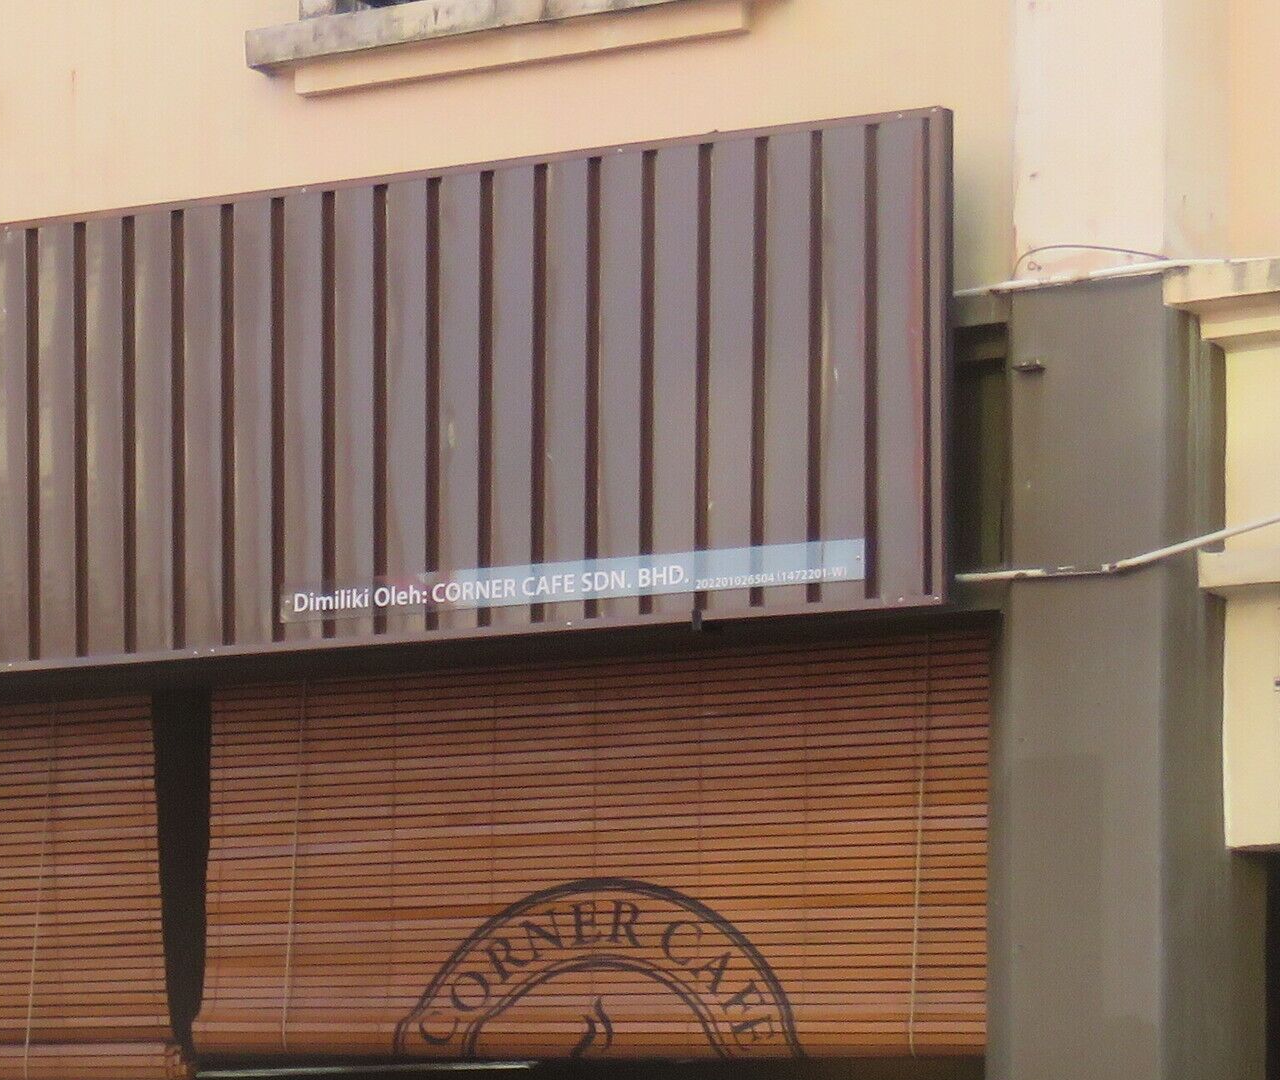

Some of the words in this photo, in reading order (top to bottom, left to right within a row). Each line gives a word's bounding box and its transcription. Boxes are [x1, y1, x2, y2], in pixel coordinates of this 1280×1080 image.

[294, 588, 369, 612] Dimiliki
[374, 584, 427, 607] Oleh:
[432, 578, 516, 602] CORNER
[521, 573, 575, 597] CAFE
[581, 569, 631, 593] SDN.
[638, 564, 689, 588] BHD.
[417, 898, 643, 1047] CORNER
[660, 918, 781, 1051] CAFE
